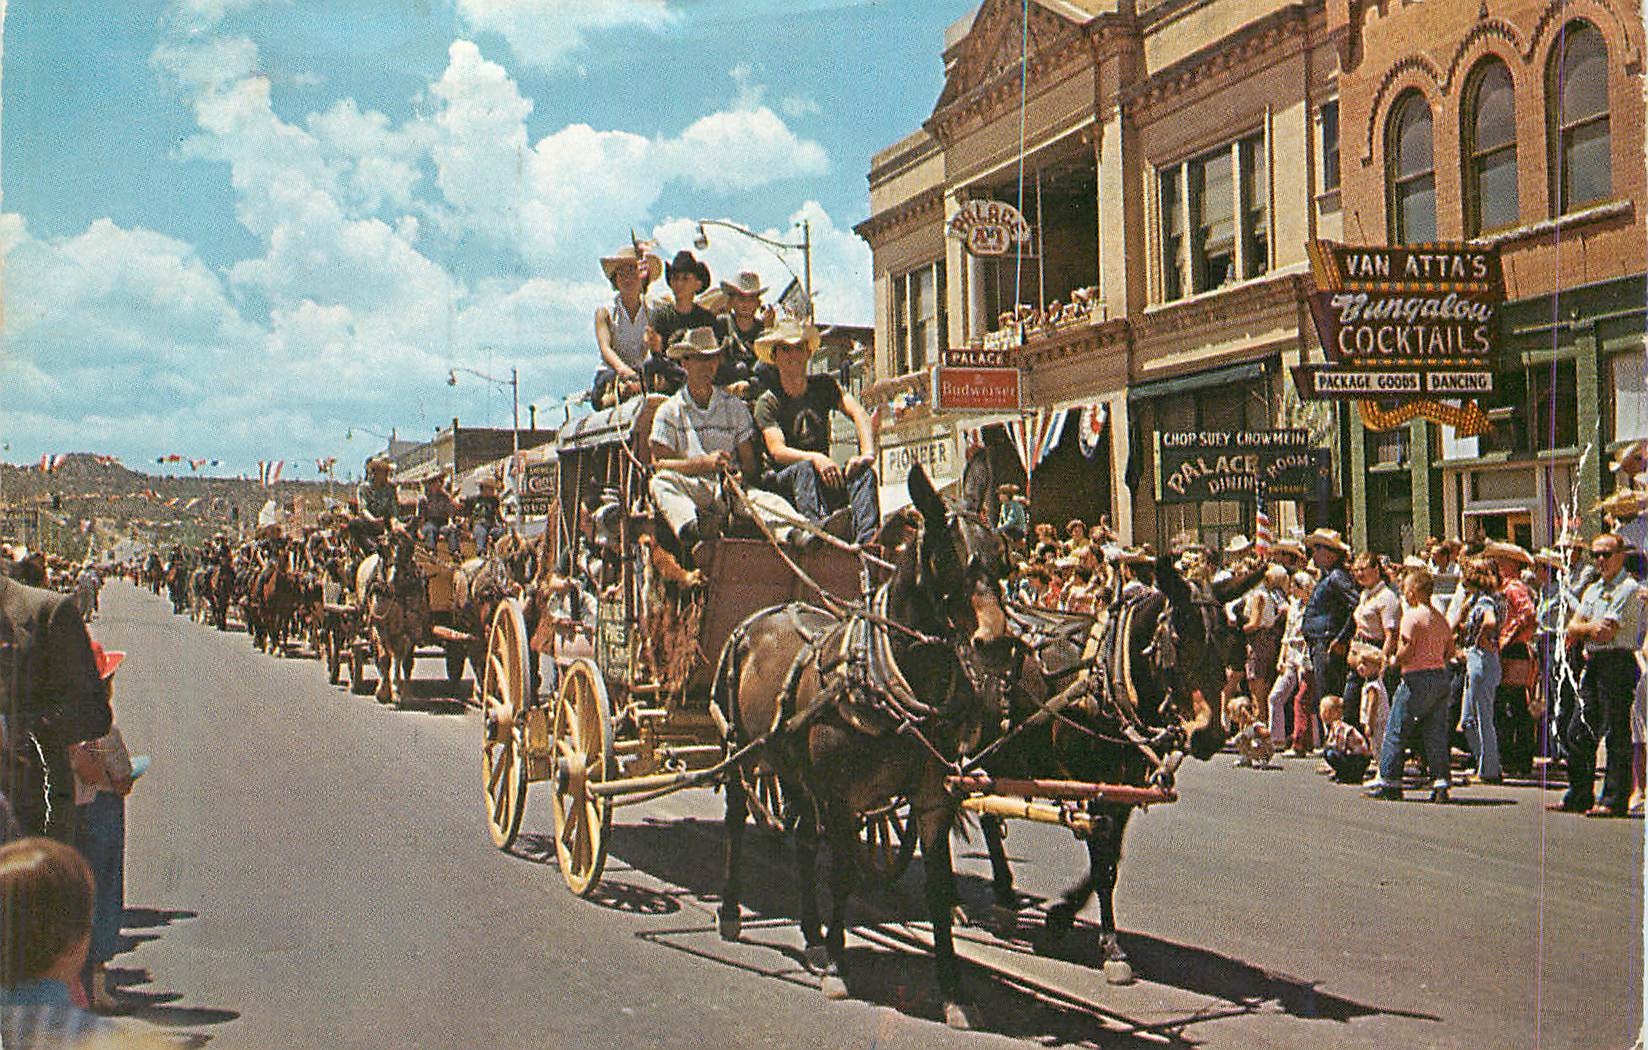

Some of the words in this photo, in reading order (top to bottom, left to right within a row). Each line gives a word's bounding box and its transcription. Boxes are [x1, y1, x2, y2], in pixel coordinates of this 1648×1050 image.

[1346, 254, 1390, 278] VAN
[1404, 254, 1488, 278] ATTA'S
[1331, 292, 1494, 324] Bungalow
[1338, 326, 1490, 355] COCKTAILS
[942, 380, 1016, 397] Budweiser
[1318, 374, 1370, 389] PACKAGE
[1377, 375, 1417, 389] GOODS
[1431, 374, 1488, 389] DANCING
[1163, 432, 1197, 446] CHOP
[1200, 432, 1231, 447] SUEY
[889, 442, 947, 471] PIONEER
[1266, 454, 1309, 479] ROOM
[1167, 454, 1259, 495] PALACE
